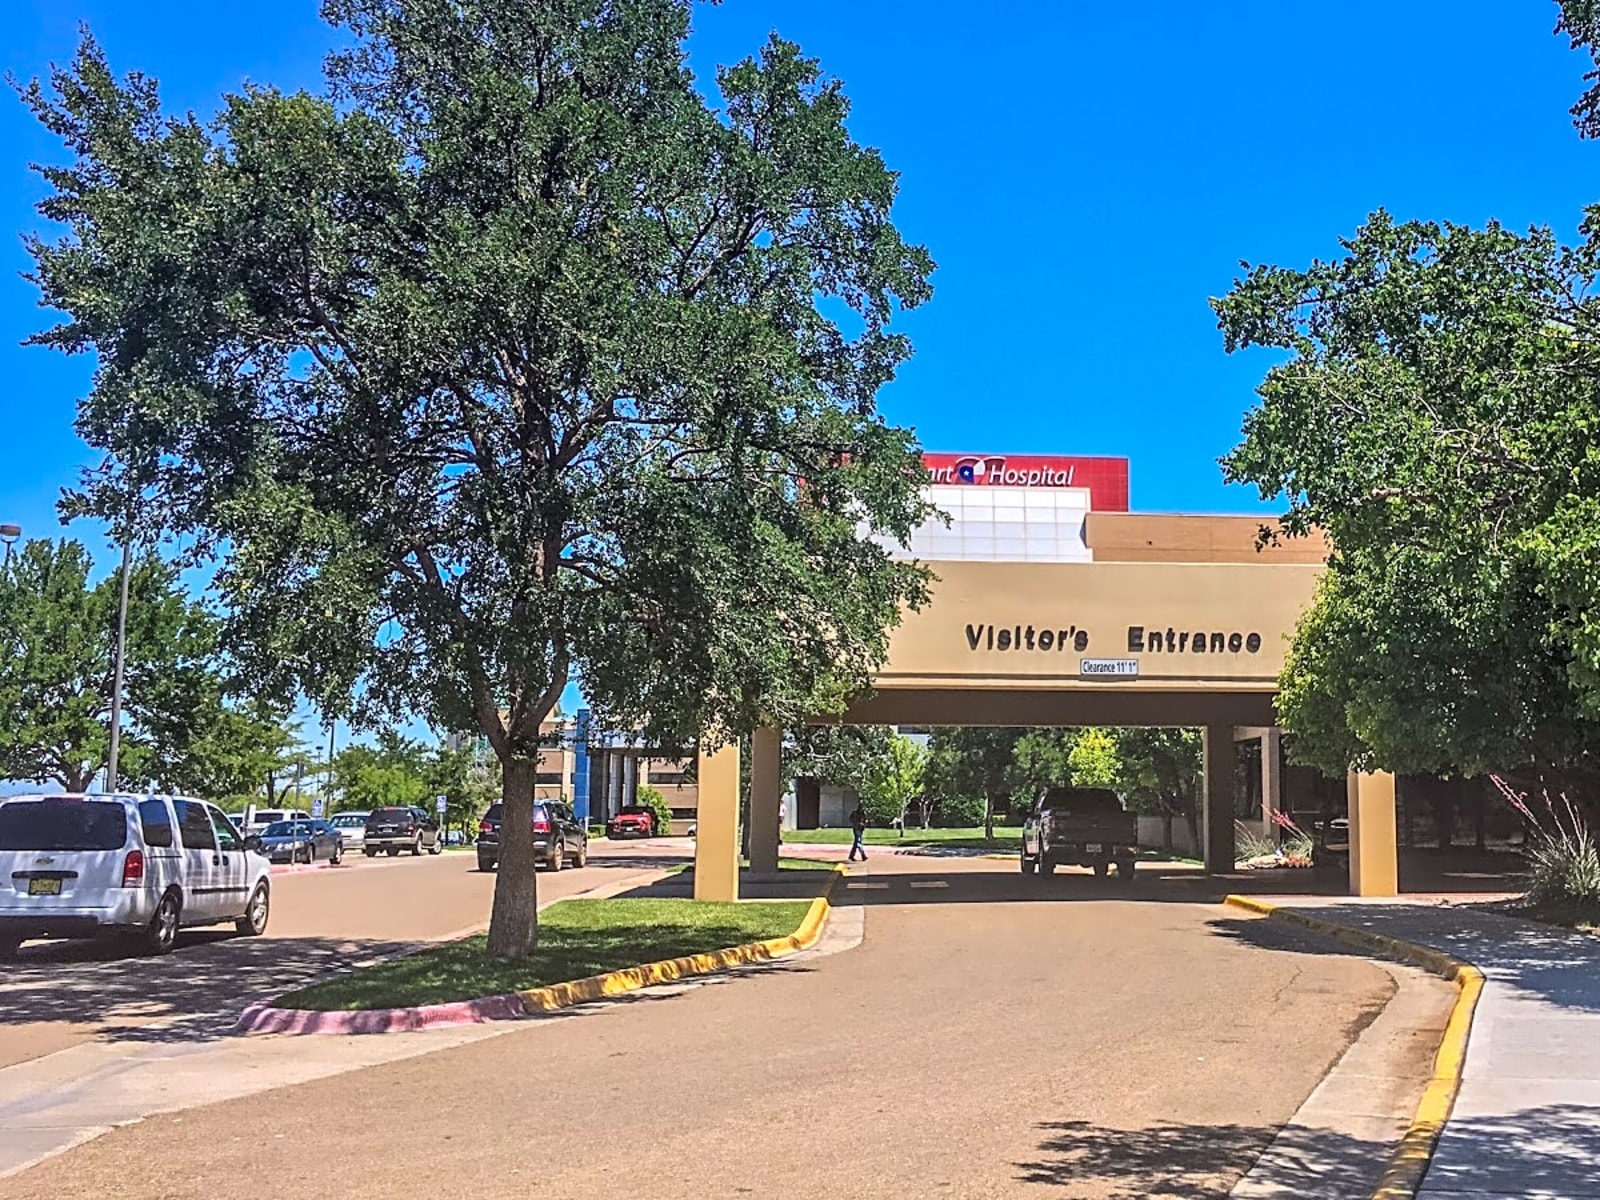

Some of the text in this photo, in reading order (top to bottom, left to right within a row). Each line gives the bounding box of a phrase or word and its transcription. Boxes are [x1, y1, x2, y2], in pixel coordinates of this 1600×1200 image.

[927, 464, 1075, 487] art Hospital
[965, 623, 1261, 654] Visitor's Entrance
[1082, 660, 1116, 673] Clearance
